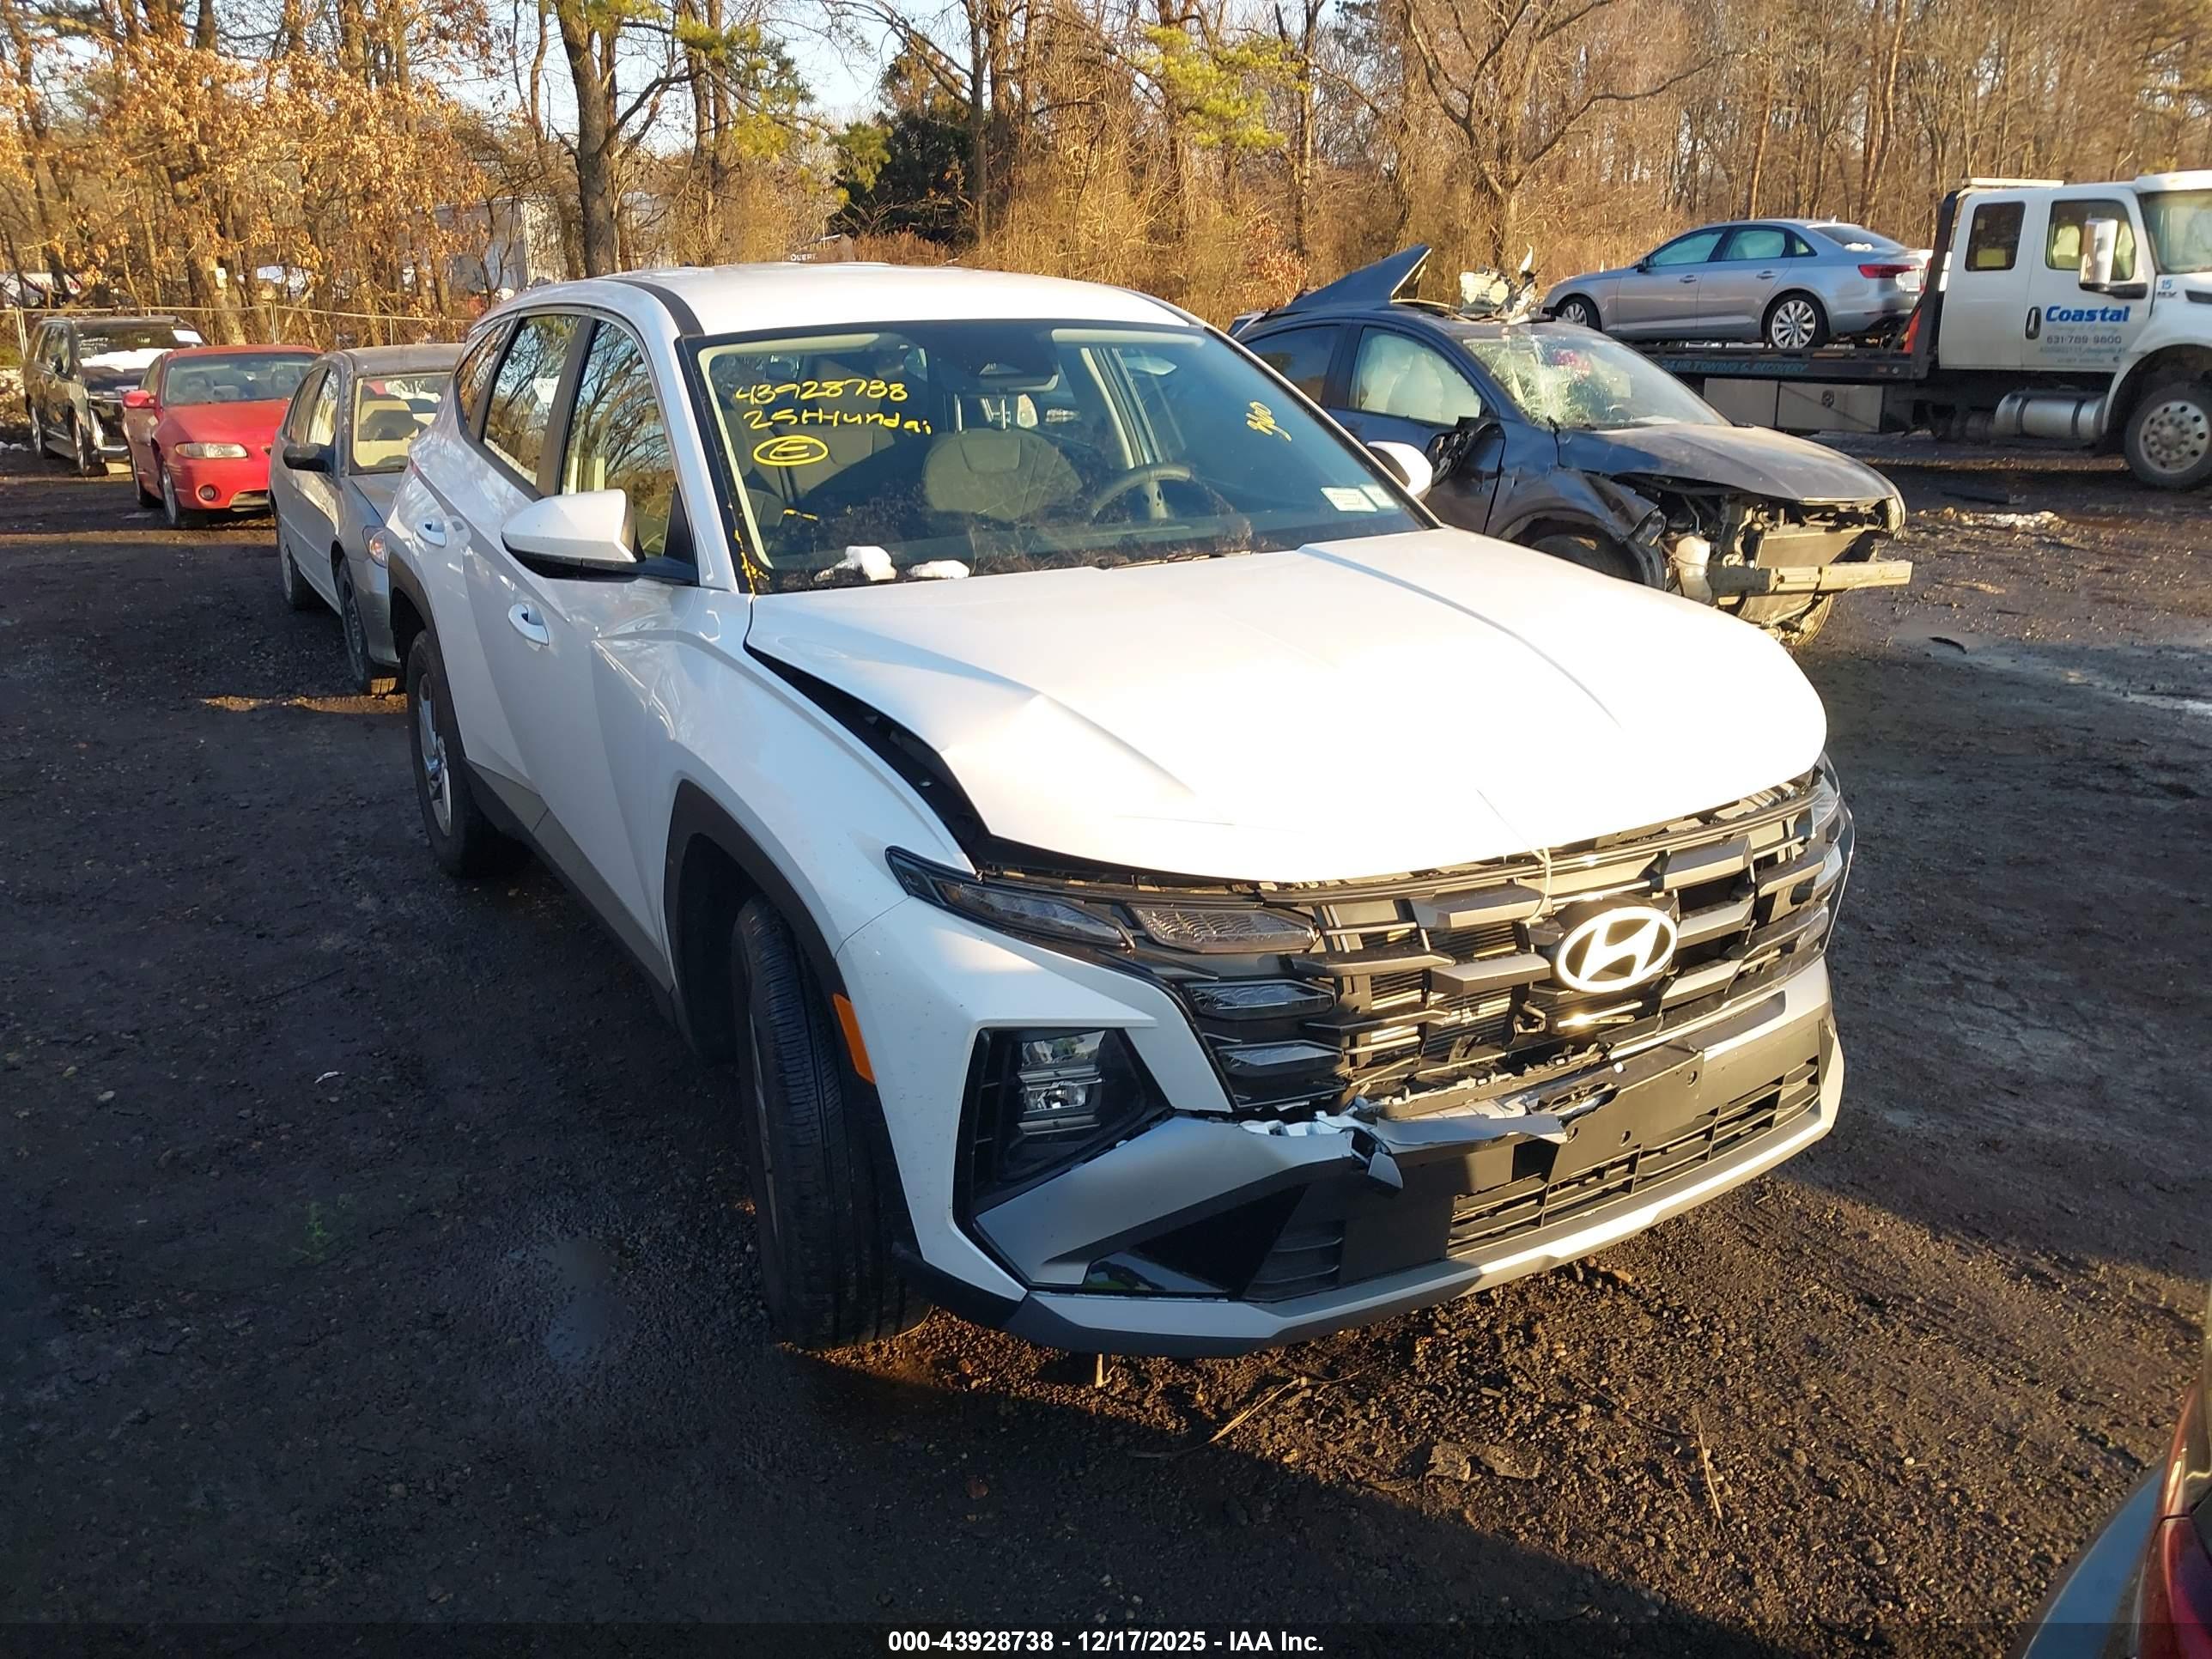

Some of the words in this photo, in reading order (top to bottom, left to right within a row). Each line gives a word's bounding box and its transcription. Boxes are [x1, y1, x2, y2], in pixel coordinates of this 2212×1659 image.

[2045, 306, 2131, 322] Coastal
[1694, 361, 1738, 372] TOWING
[1753, 362, 1808, 373] RECOVERY
